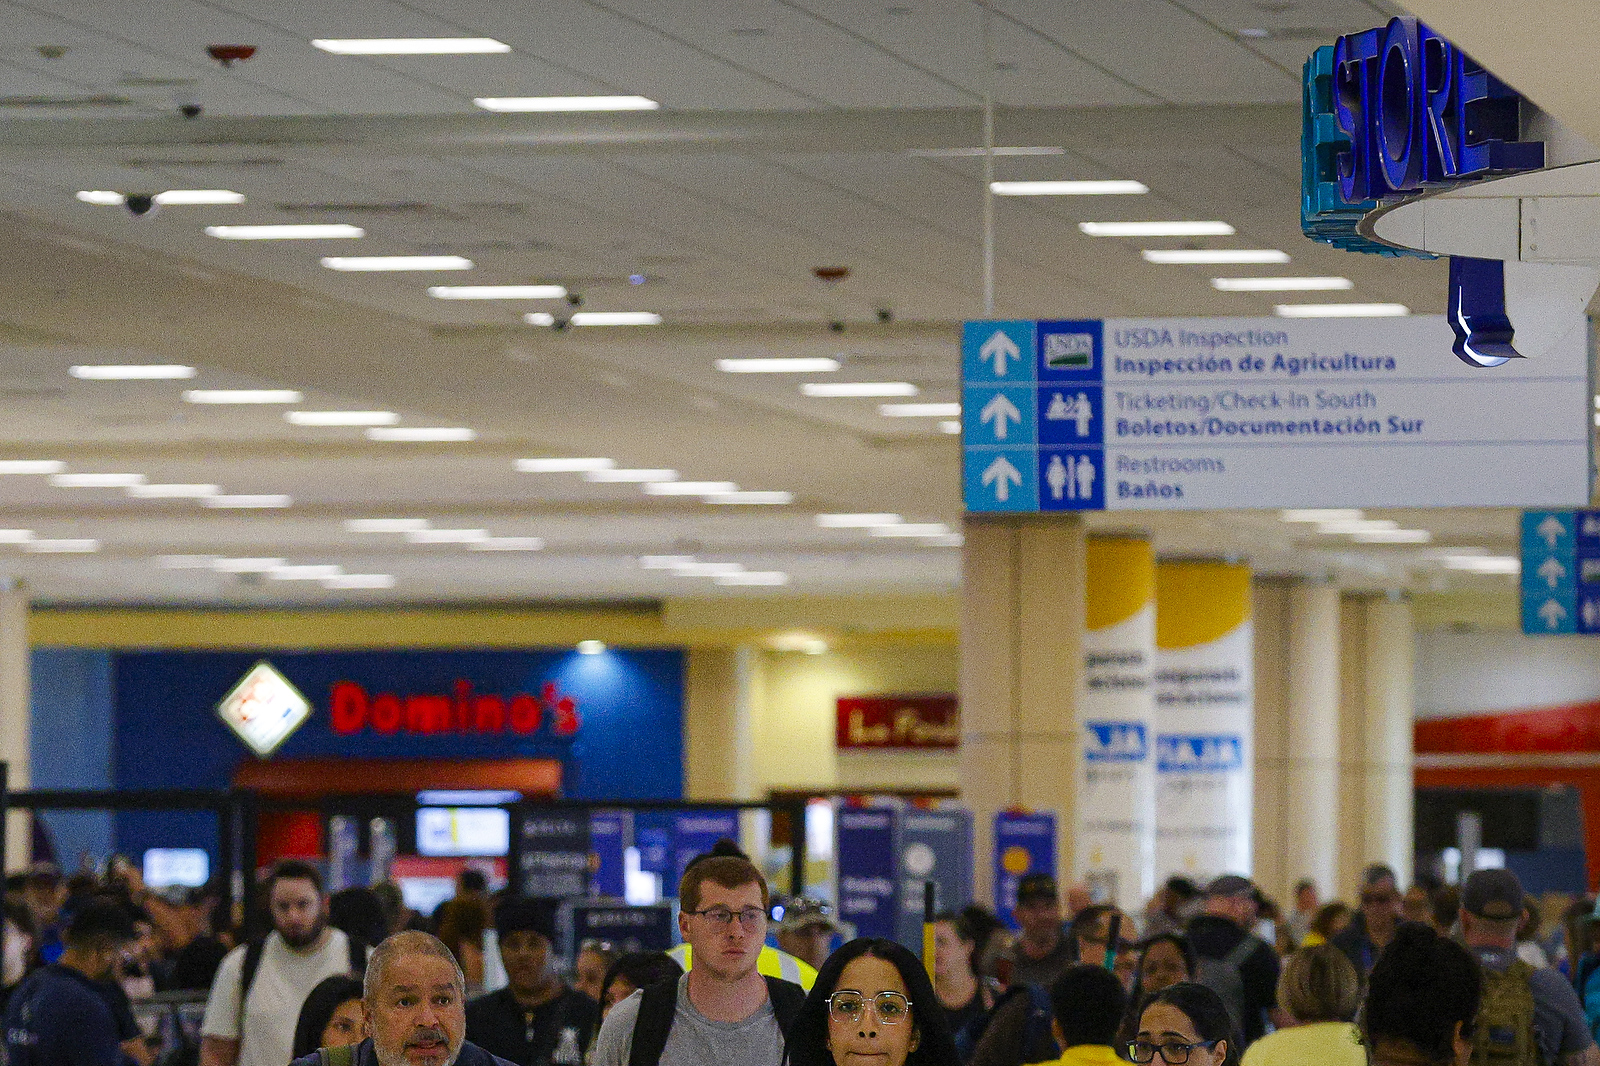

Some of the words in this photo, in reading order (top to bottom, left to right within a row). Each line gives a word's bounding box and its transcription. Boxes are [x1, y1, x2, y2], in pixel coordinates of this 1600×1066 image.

[1114, 328, 1173, 348] USDA
[1179, 329, 1289, 350] Inspection
[1114, 354, 1234, 376] Inspección
[1238, 354, 1266, 372] de
[1272, 353, 1397, 376] Agricultura
[1115, 390, 1310, 413] Ticketing/Check-In
[1316, 389, 1378, 410] South
[1116, 416, 1382, 437] Boletos/Documentación
[1388, 416, 1425, 434] Sur
[1116, 455, 1226, 474] Restrooms
[1117, 480, 1185, 499] Baños
[330, 679, 583, 736] Domino's
